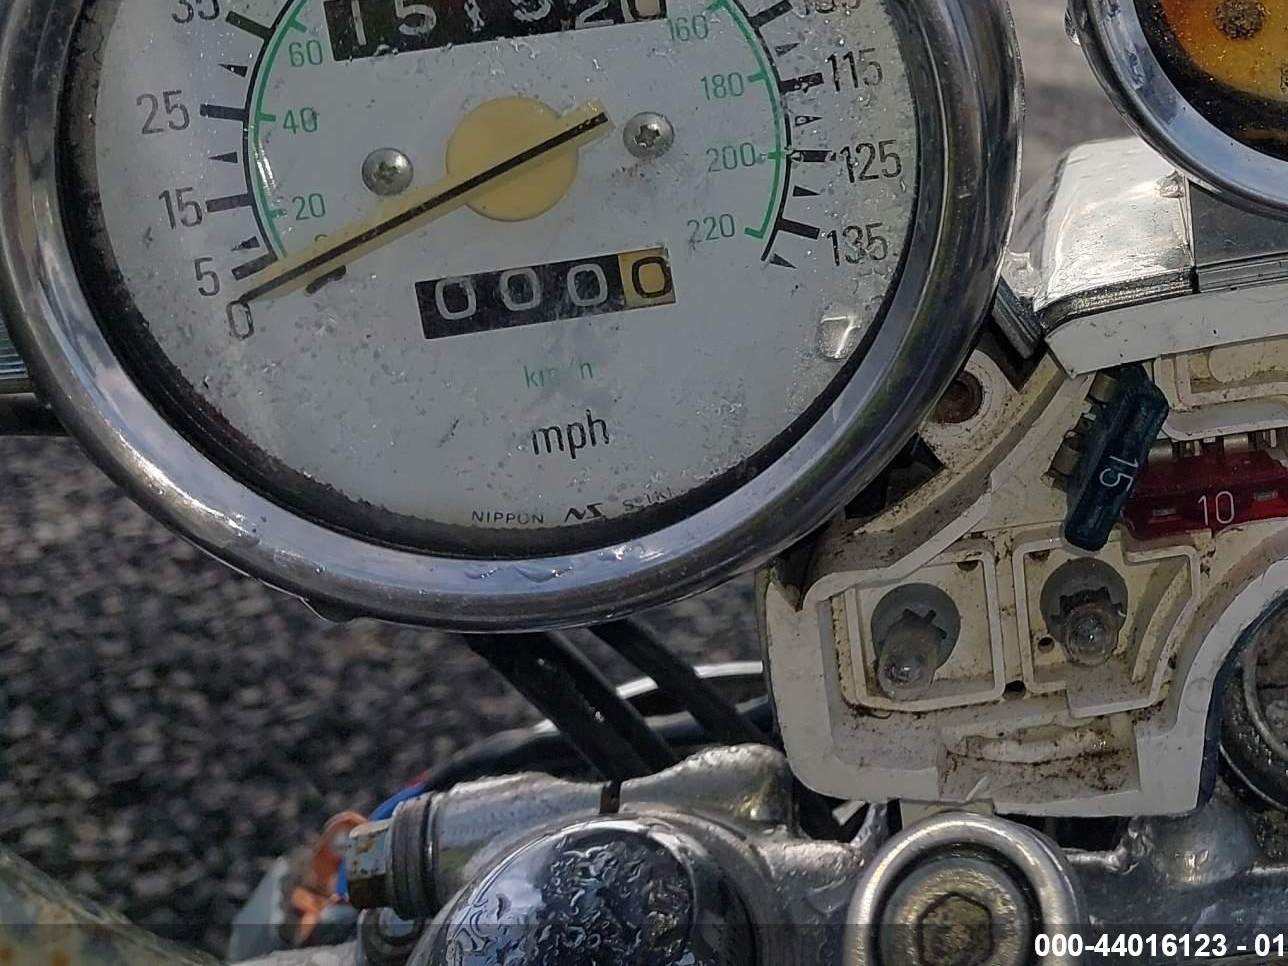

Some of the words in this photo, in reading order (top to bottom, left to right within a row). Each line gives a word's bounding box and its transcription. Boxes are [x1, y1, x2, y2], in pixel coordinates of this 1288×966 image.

[667, 15, 709, 42] 160
[288, 39, 324, 68] 60
[826, 47, 884, 93] 115
[701, 71, 745, 100] 180
[136, 90, 191, 135] 25
[283, 107, 319, 134] 40
[706, 142, 757, 172] 200
[841, 139, 902, 184] 125
[158, 186, 203, 230] 15
[294, 192, 327, 221] 20
[687, 214, 736, 245] 220
[826, 222, 889, 267] 135
[194, 257, 221, 297] 5
[435, 255, 673, 321] 0000
[225, 299, 255, 341] 0
[531, 408, 610, 460] mph
[1099, 454, 1140, 492] 15
[471, 510, 544, 525] NIPPON
[1197, 490, 1236, 527] 10
